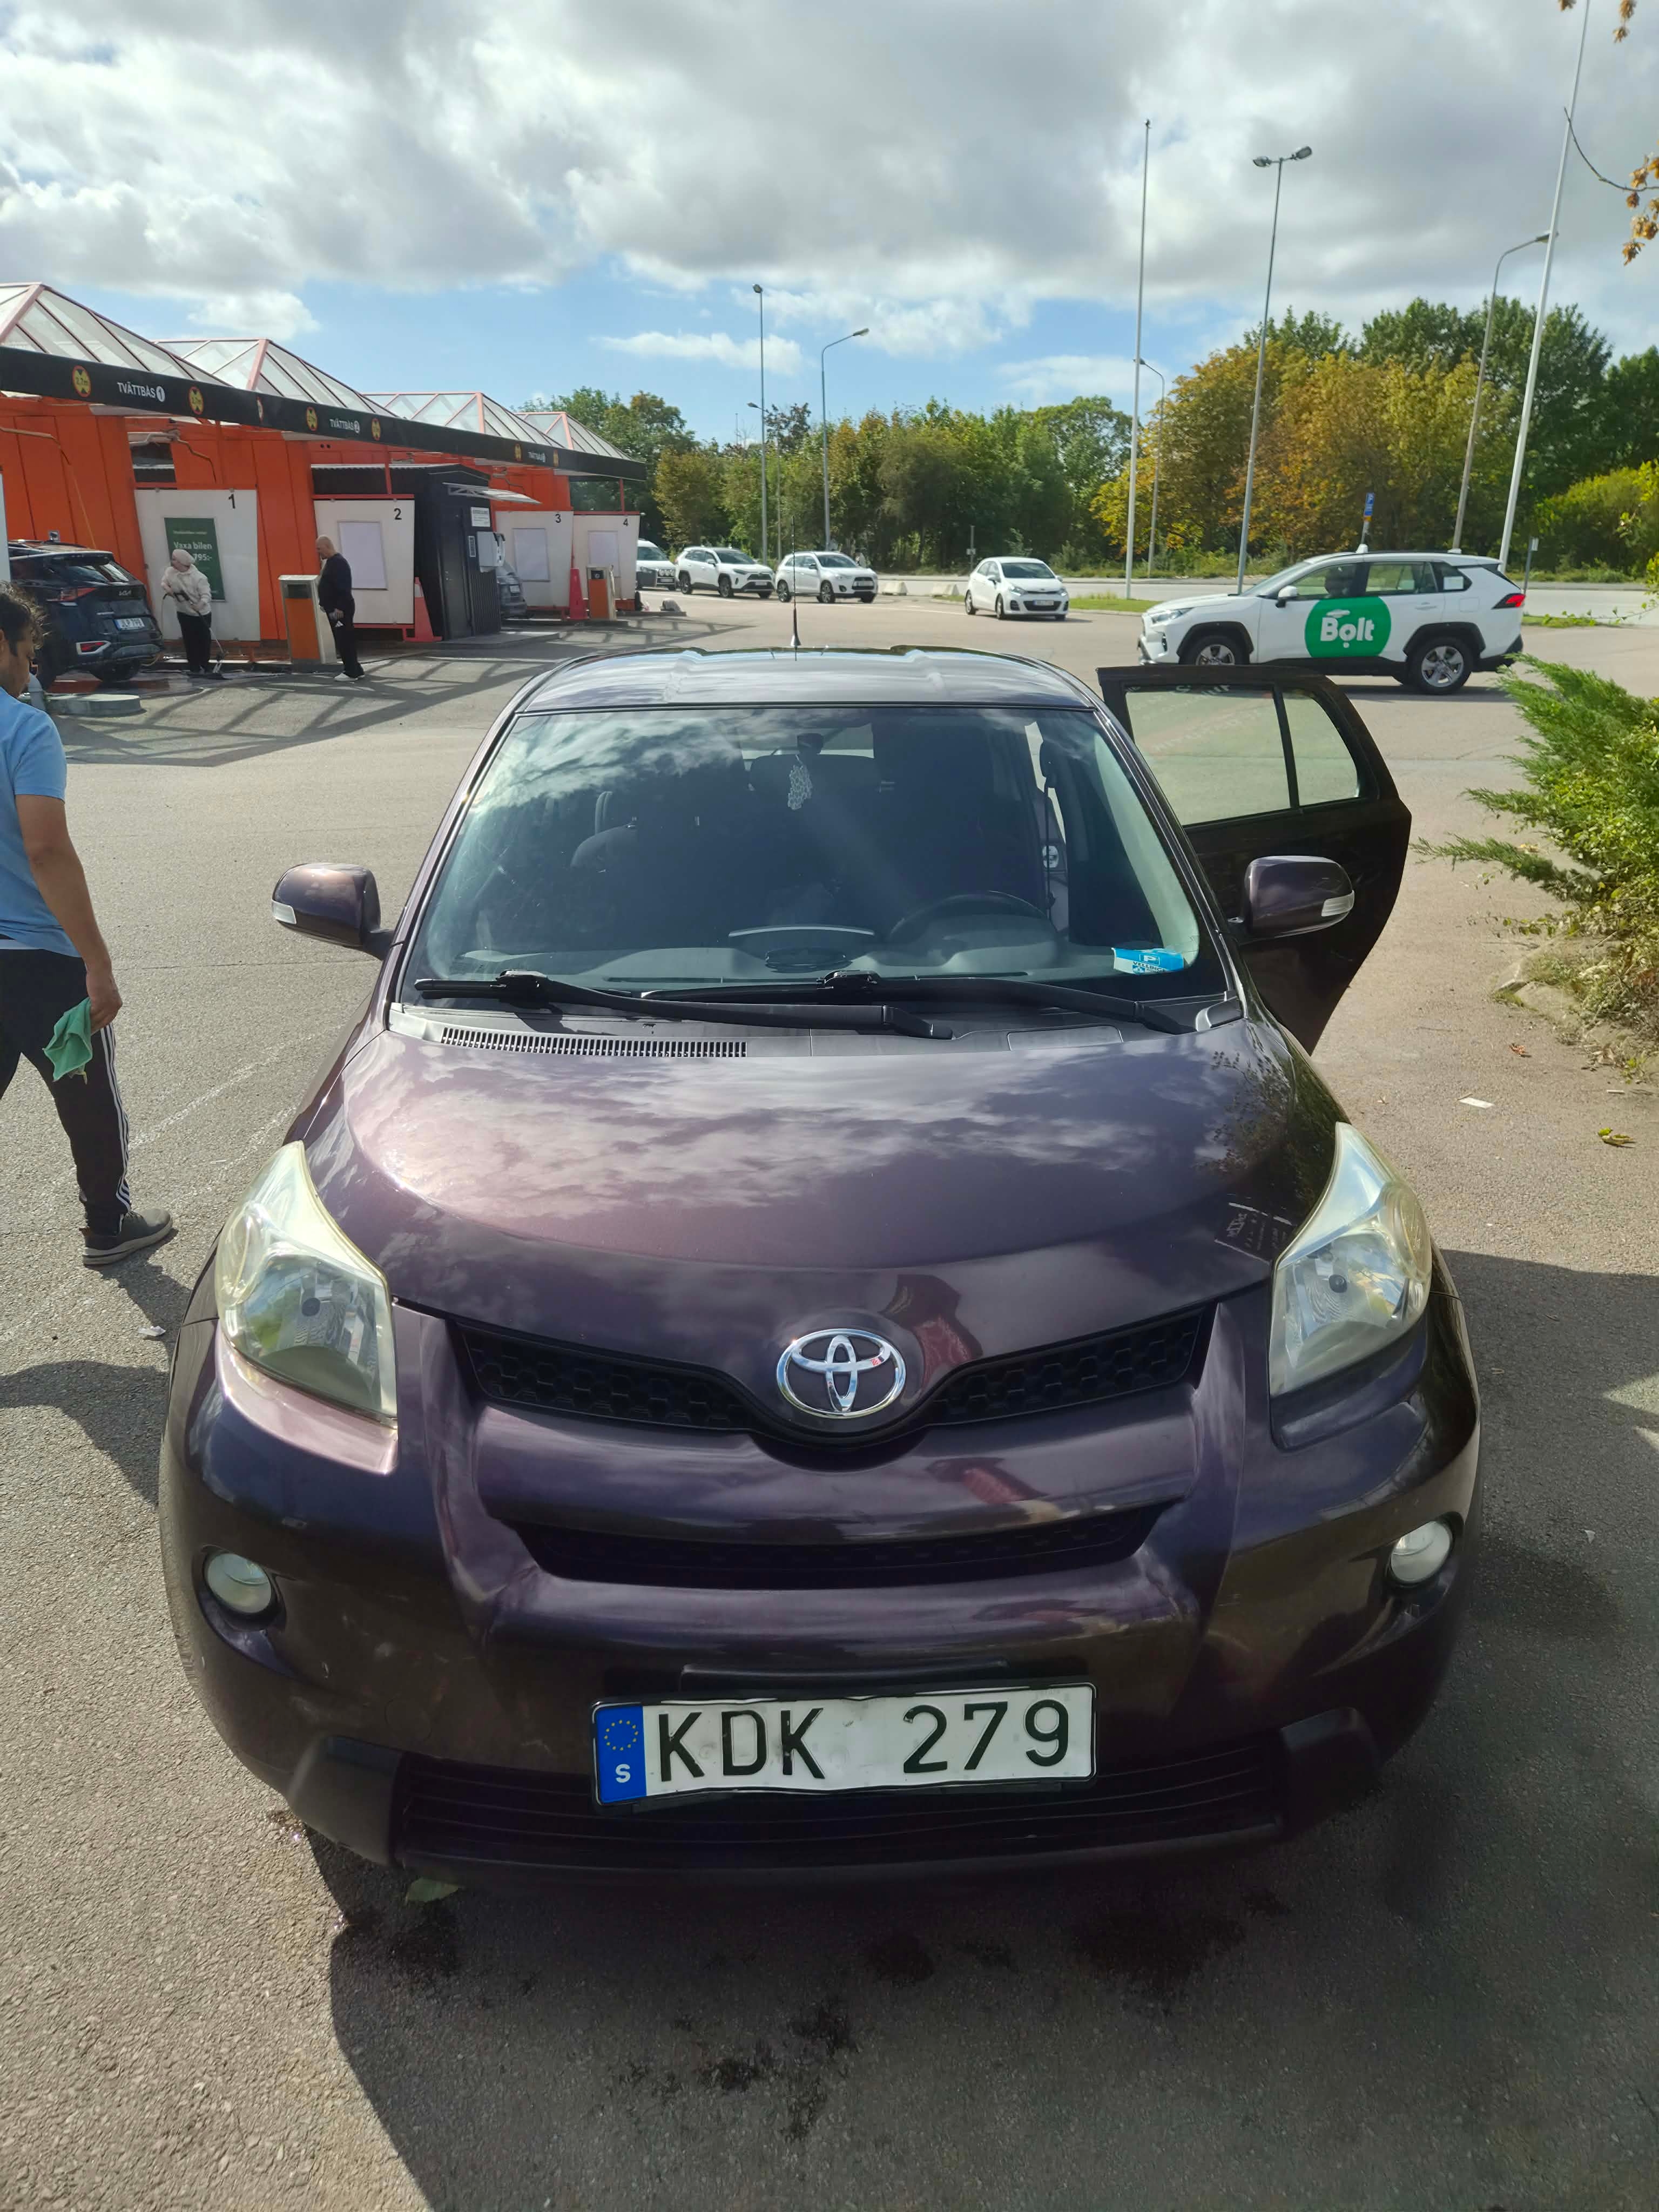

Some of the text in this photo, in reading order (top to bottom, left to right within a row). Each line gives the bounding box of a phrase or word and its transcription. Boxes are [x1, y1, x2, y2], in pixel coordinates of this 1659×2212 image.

[117, 381, 156, 399] TVÄTTBÅS
[228, 494, 235, 509] 1
[394, 508, 402, 520] 2
[555, 514, 562, 523] 3
[623, 518, 629, 527] 4
[1320, 617, 1374, 648] Bolt
[658, 1699, 1069, 1782] KDK 279
[616, 1764, 631, 1783] S
